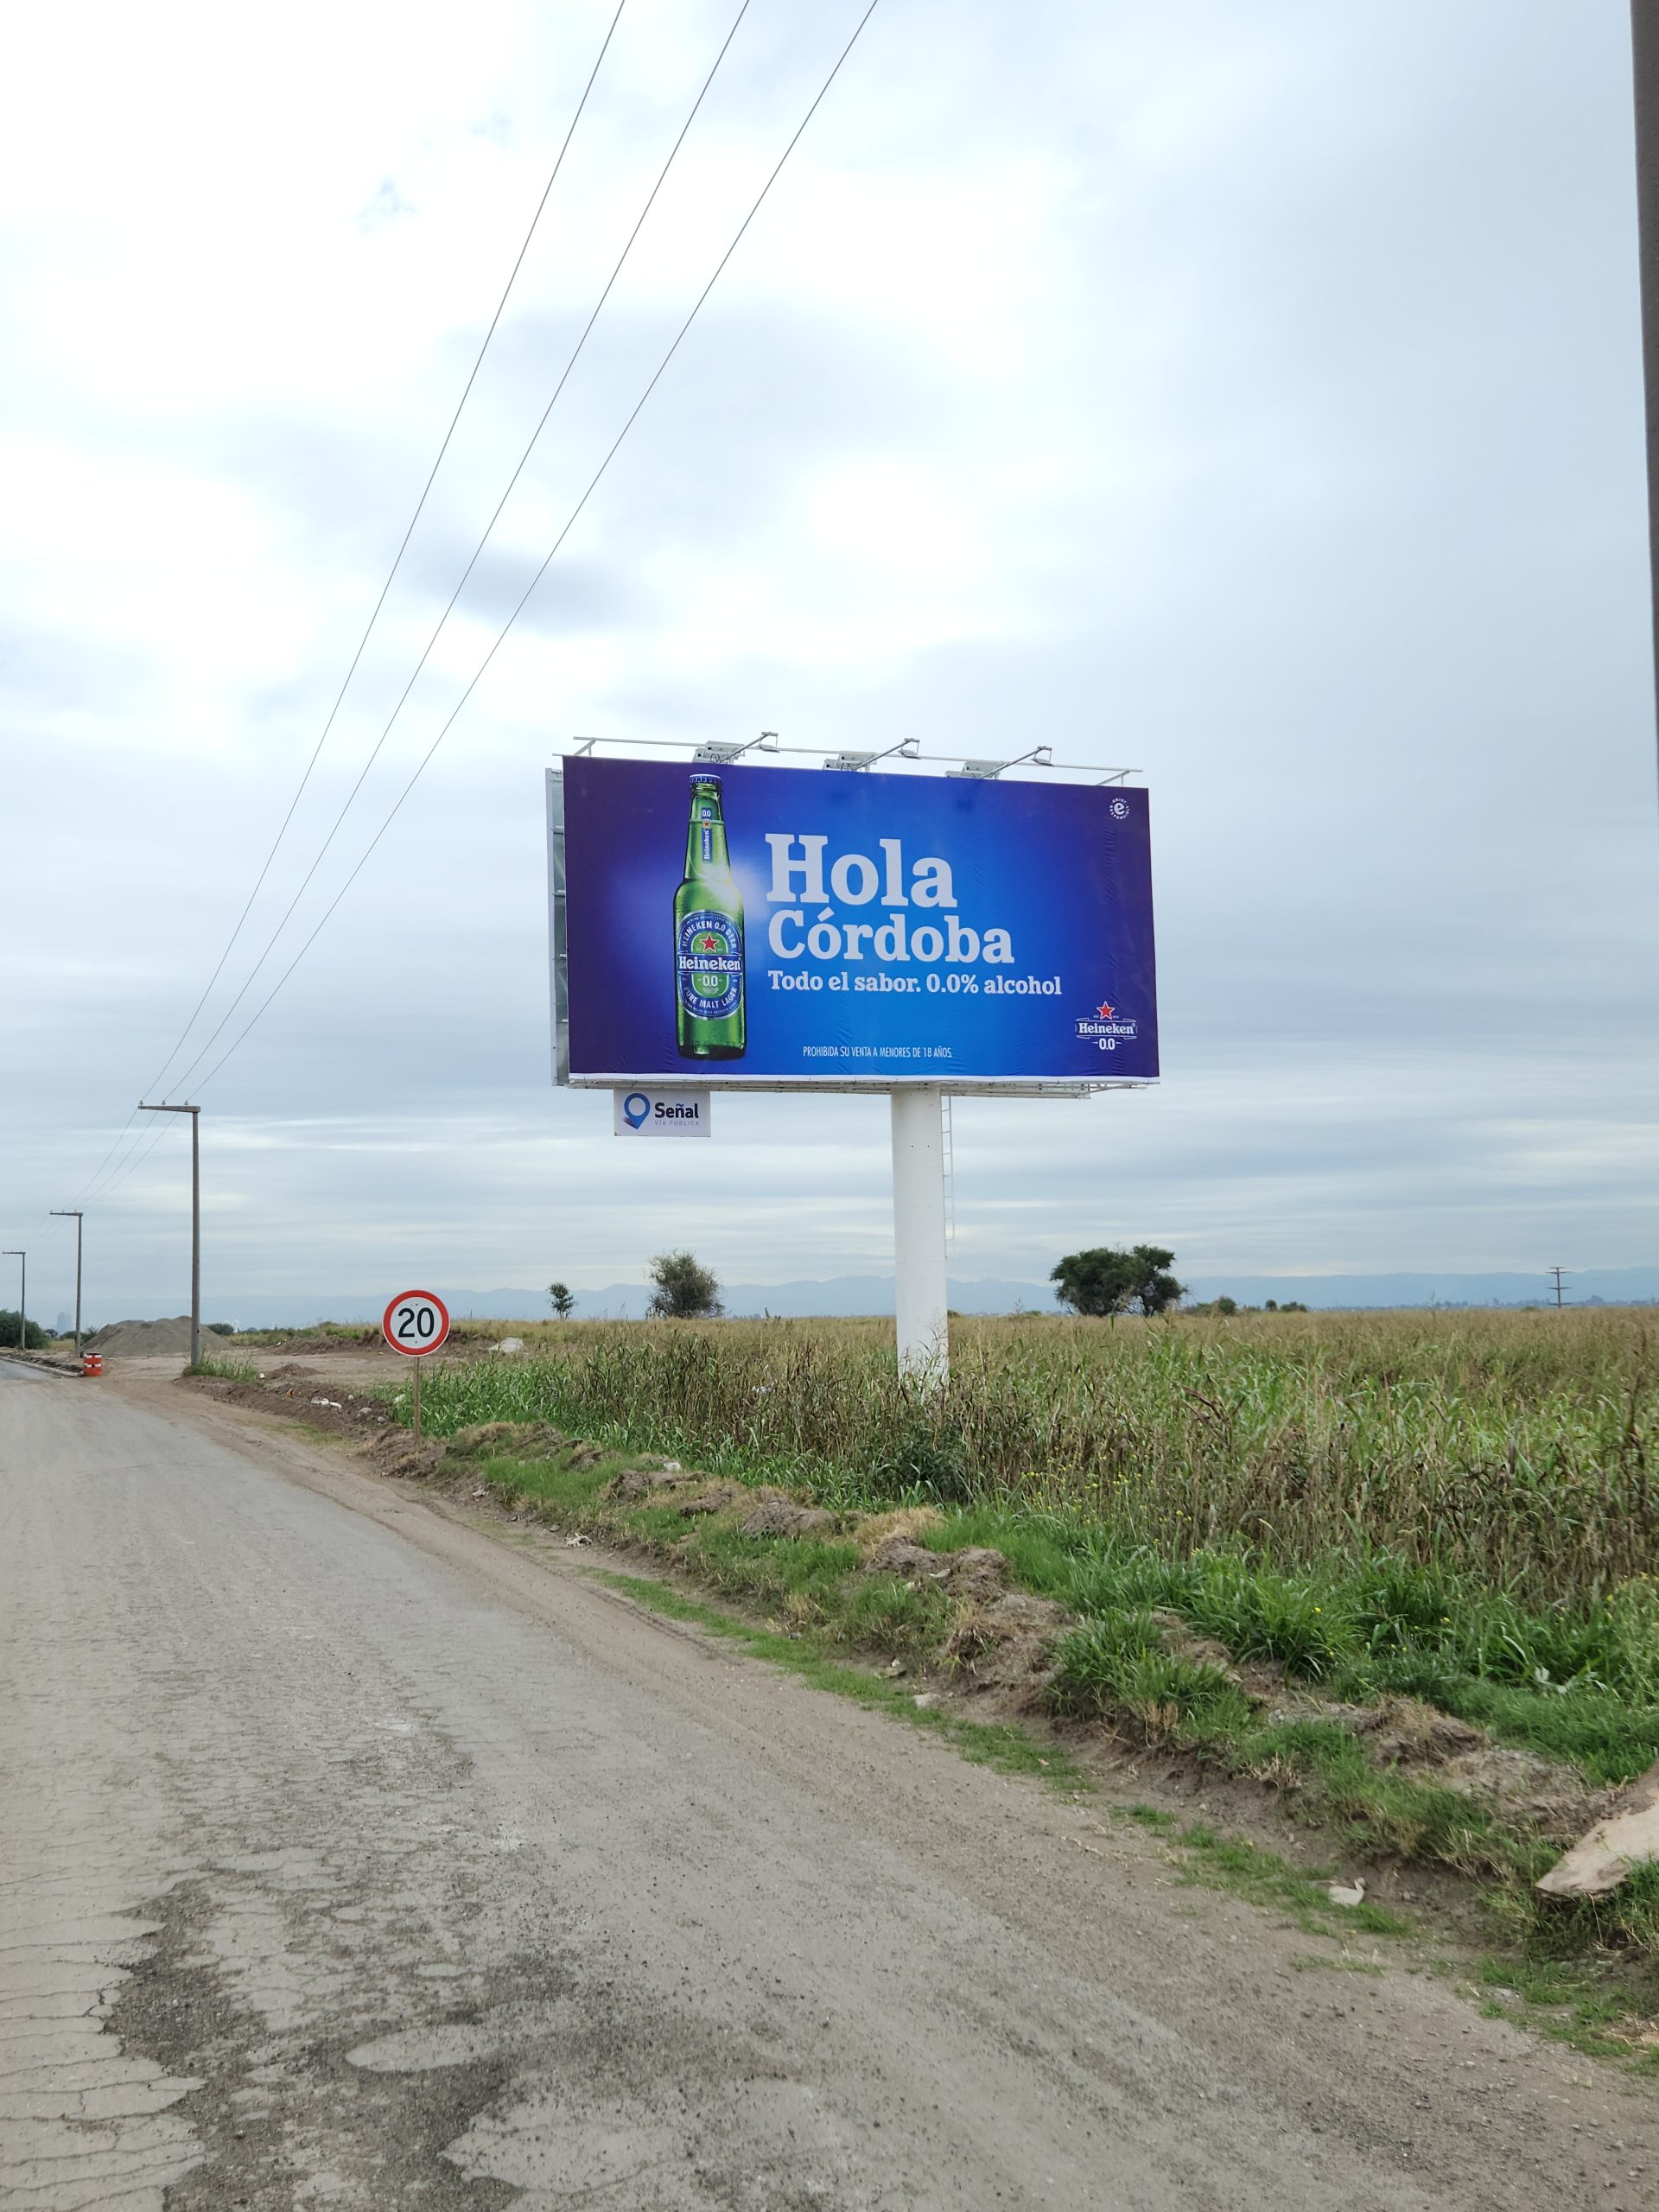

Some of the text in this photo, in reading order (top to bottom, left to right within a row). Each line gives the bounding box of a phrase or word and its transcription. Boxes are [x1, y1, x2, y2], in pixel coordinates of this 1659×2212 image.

[765, 833, 958, 908] Hola
[682, 920, 712, 946] HEINEKEN
[725, 928, 736, 949] BEER
[768, 906, 1015, 963] Córdoba
[679, 956, 741, 970] Heineken
[702, 975, 718, 987] 0.0
[768, 969, 1062, 995] Todo el sabor. 0.0% alcohol
[683, 986, 697, 1005] PURE
[699, 1000, 720, 1009] MALT
[721, 987, 738, 1007] LAGER
[1078, 1022, 1135, 1033] Heineken
[803, 1046, 838, 1057] PROHIBIDA
[840, 1046, 849, 1057] SU
[851, 1046, 872, 1057] VENTA
[873, 1047, 878, 1058] A
[880, 1047, 911, 1058] MENORES
[912, 1047, 921, 1058] DE
[923, 1047, 932, 1058] 18
[1098, 1038, 1116, 1050] 0.0
[654, 1102, 699, 1119] Señal
[397, 1307, 434, 1338] 20
